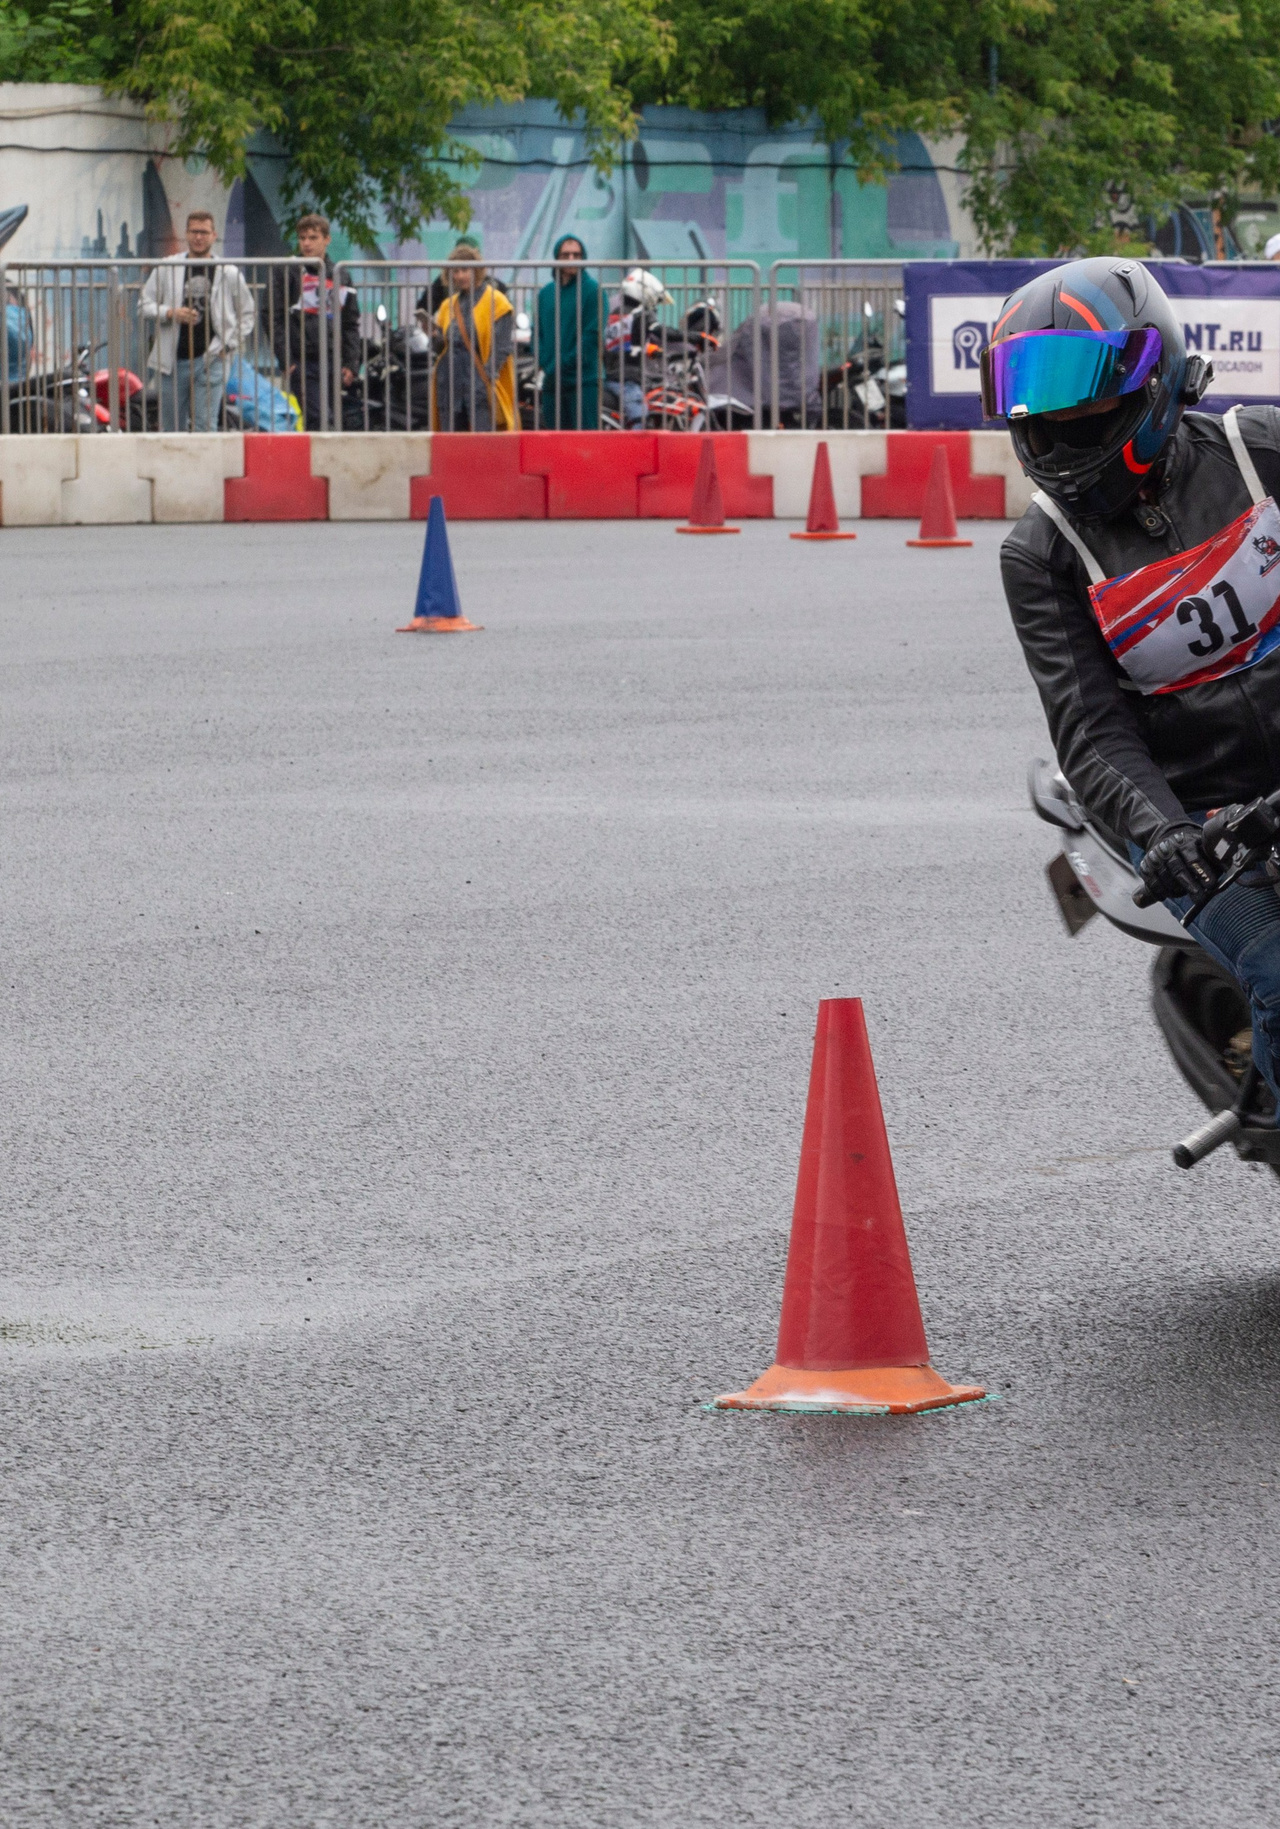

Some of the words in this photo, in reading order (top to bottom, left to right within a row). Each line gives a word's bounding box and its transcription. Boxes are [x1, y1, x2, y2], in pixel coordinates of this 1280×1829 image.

[1184, 324, 1262, 351] NT.RU
[1212, 361, 1262, 373] ТОСАЛОН
[1177, 580, 1258, 656] 31
